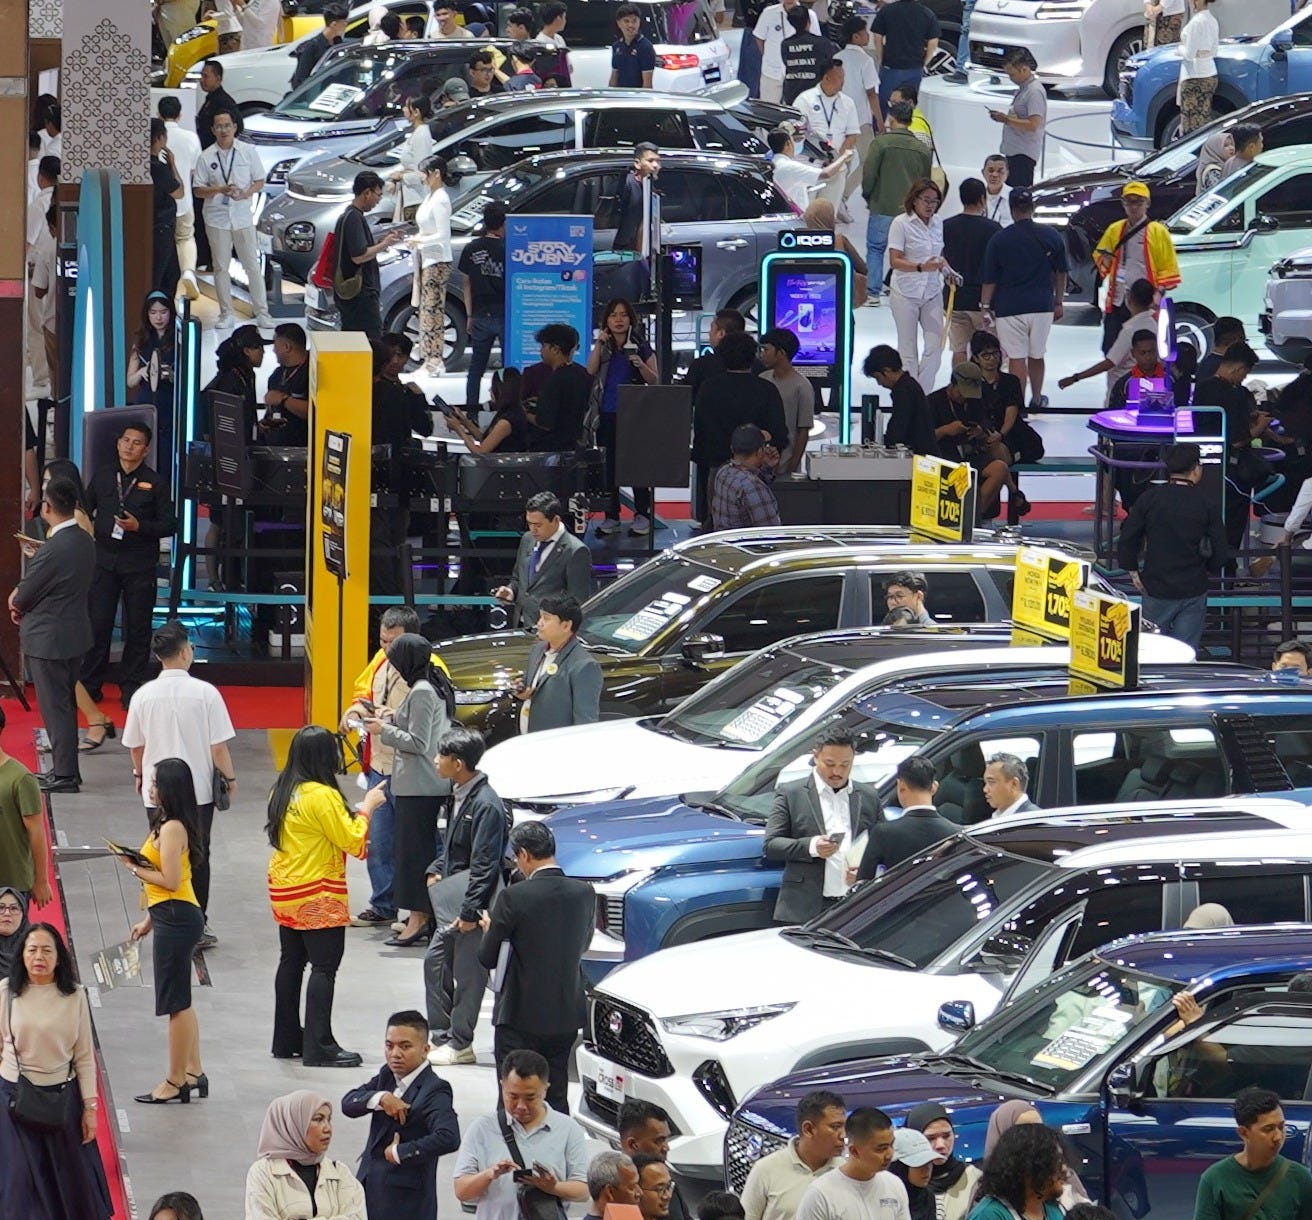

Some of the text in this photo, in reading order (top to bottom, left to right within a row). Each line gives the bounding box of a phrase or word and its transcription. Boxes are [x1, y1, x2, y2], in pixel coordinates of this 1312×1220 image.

[789, 44, 814, 53] HAPPY
[797, 235, 833, 247] IQOS
[528, 241, 577, 254] STORY
[511, 248, 586, 266] JOURNEY
